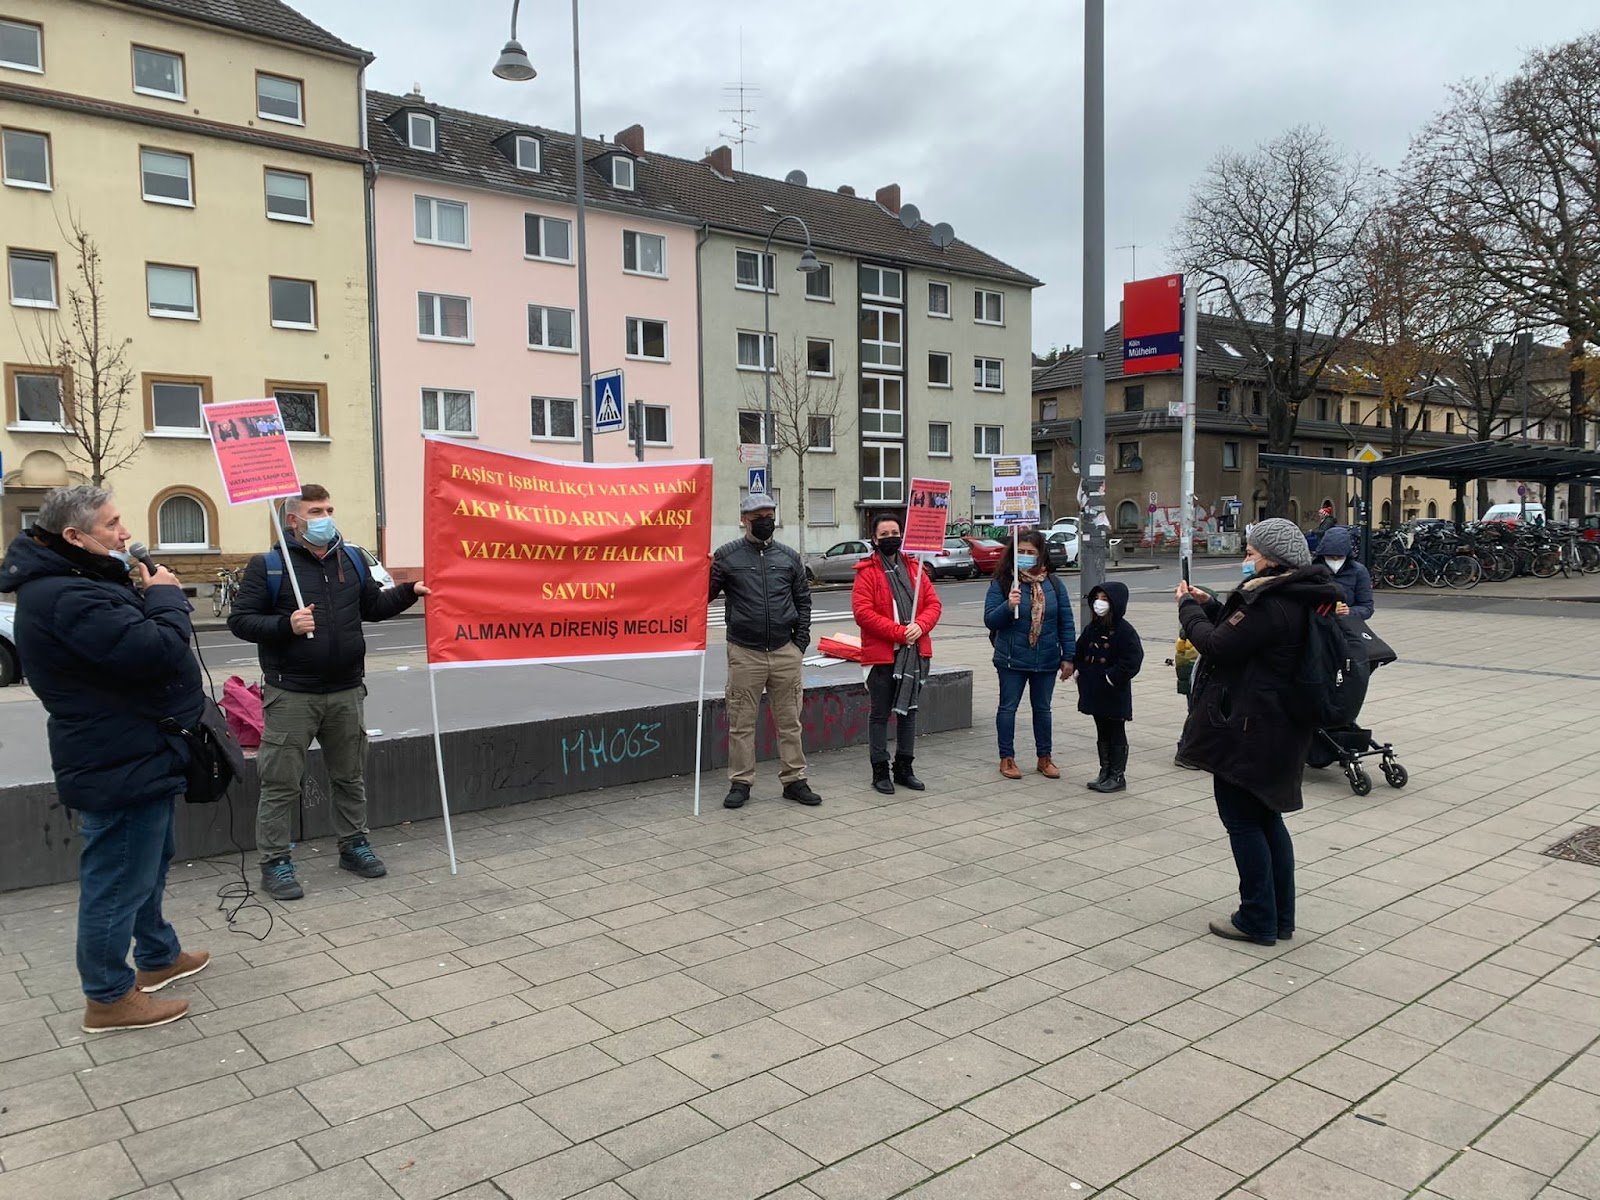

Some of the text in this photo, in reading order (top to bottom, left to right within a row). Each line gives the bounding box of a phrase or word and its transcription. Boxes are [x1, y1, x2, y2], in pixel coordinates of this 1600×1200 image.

[1129, 346, 1157, 357] Mülheim
[451, 463, 697, 497] FAŞİST İŞBİRLİKÇİ VATAN HAİNİ
[453, 499, 693, 529] AKP İKTİDARINA KARŞI
[460, 539, 685, 562] VATANINI VE HALKINI
[542, 582, 616, 600] SAVUN!
[455, 614, 688, 640] ALMANYA DİRENİŞ MECLİSİ
